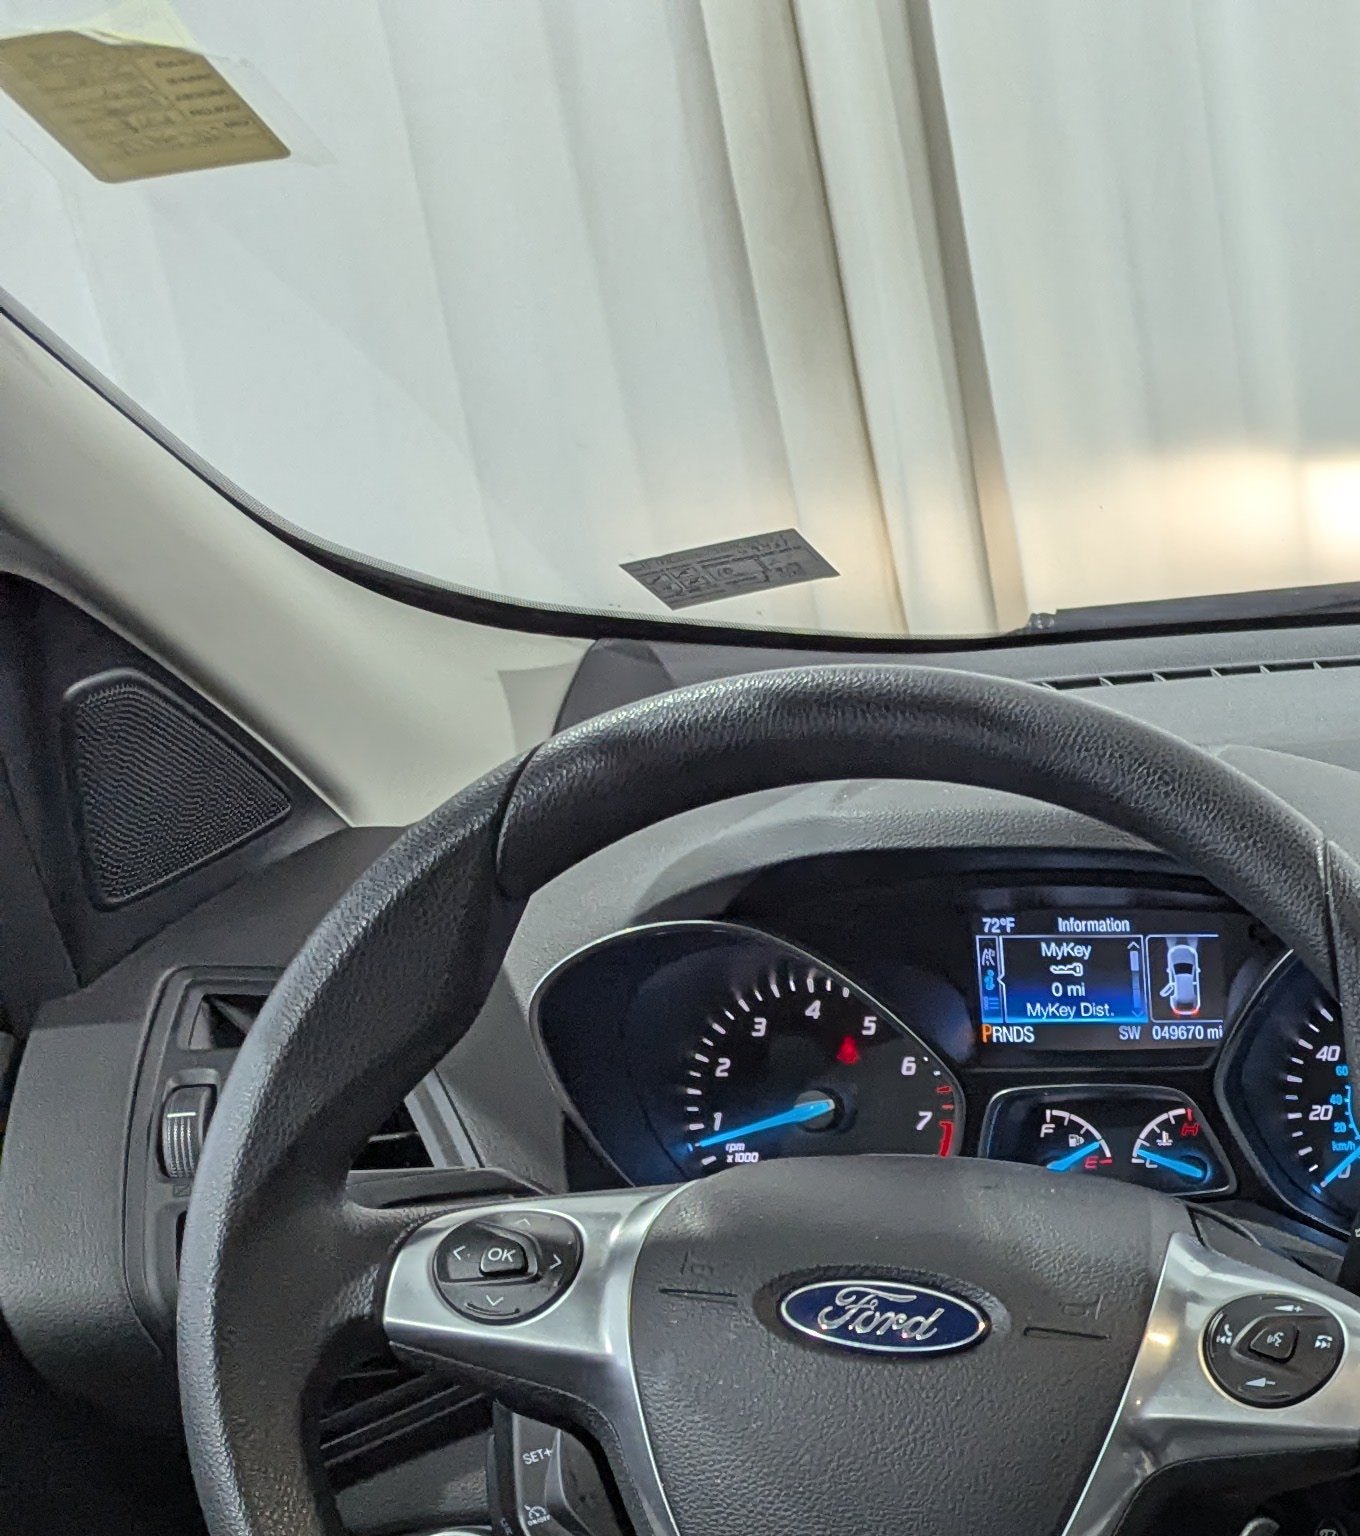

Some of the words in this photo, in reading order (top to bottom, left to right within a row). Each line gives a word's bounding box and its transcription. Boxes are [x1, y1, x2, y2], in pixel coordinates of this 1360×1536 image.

[1058, 917, 1131, 932] Information
[1041, 942, 1092, 960] MyKey
[1051, 982, 1063, 997] 0
[1067, 982, 1086, 997] mi
[805, 1000, 821, 1020] 4
[1026, 1002, 1076, 1020] MyKey
[1080, 1002, 1115, 1017] Dist.
[751, 1017, 767, 1037] 3
[861, 1016, 877, 1036] 5
[982, 1024, 1035, 1043] PRNDS
[1118, 1025, 1142, 1040] SW
[1152, 1025, 1204, 1040] 049670
[1207, 1025, 1223, 1039] mi
[1315, 1045, 1341, 1061] 40
[715, 1058, 731, 1077] 2
[901, 1057, 917, 1076] 6
[1308, 1104, 1333, 1120] 20
[713, 1112, 723, 1131] 1
[915, 1111, 933, 1131] 7
[1040, 1124, 1056, 1138] F
[1181, 1123, 1200, 1137] H
[725, 1143, 745, 1152] rpm
[1331, 1140, 1356, 1152] km/h
[1084, 1156, 1098, 1169] E
[487, 1247, 517, 1263] OK
[817, 1286, 945, 1341] Ford
[522, 1447, 553, 1465] SET+
